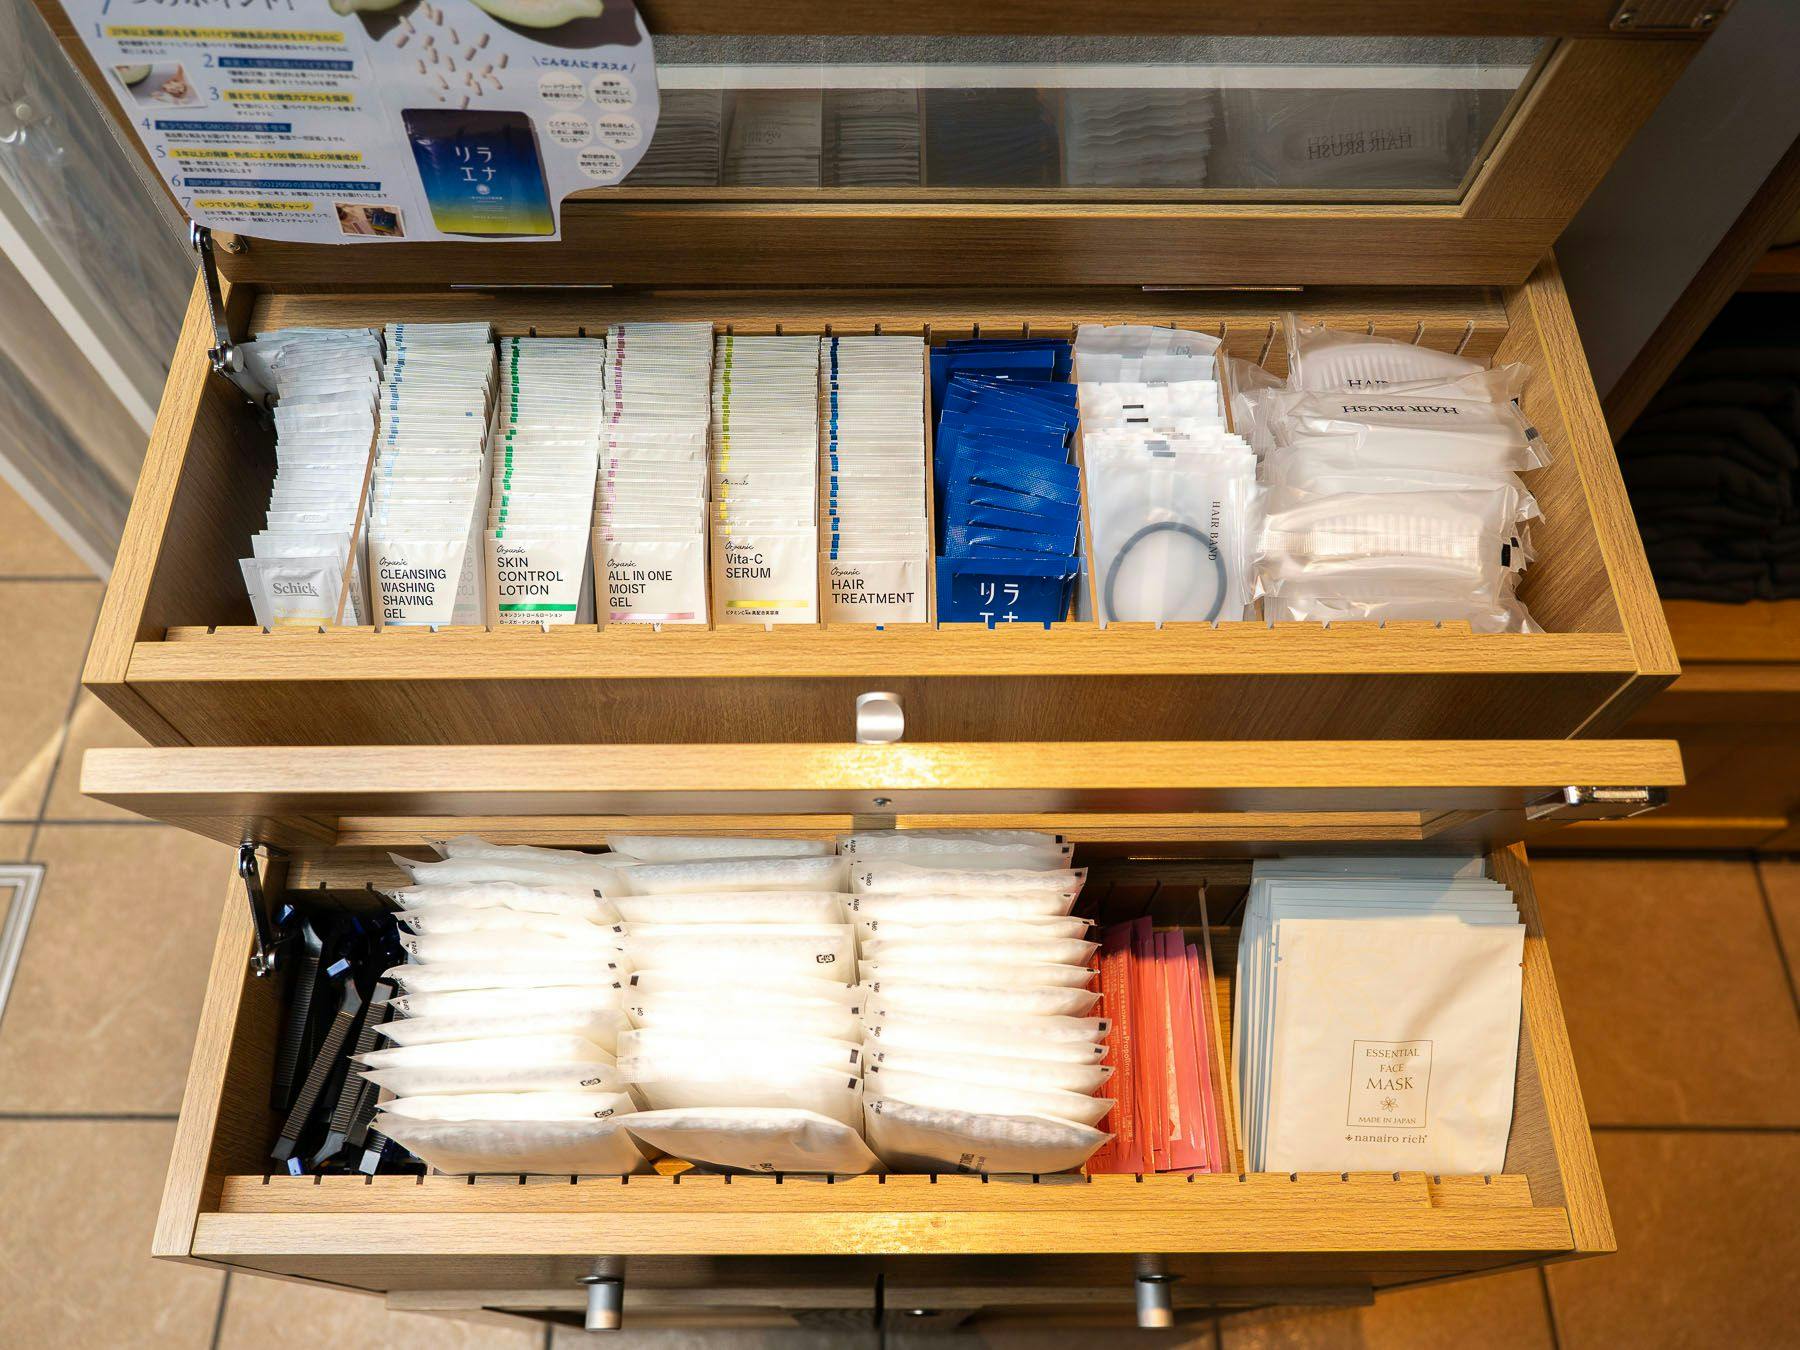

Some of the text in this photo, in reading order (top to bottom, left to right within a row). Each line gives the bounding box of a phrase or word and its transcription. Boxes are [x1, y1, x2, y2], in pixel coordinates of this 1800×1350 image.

[203, 54, 215, 69] 2
[209, 87, 220, 101] 3
[142, 118, 151, 131] 4
[154, 145, 167, 159] 5
[171, 174, 181, 187] 6
[182, 196, 191, 208] 7
[1342, 405, 1406, 414] BRUSH
[1208, 501, 1221, 561] HAIR BAND
[497, 544, 526, 554] Organic
[725, 541, 755, 551] Organic
[379, 556, 408, 567] Organic
[497, 557, 529, 568] SKIN
[607, 558, 637, 568] Organic
[726, 553, 764, 565] Vita-C
[380, 568, 447, 580] CLEANSING
[498, 570, 564, 582] CONTROL
[608, 570, 673, 581] ALL IN ONE
[726, 567, 772, 579] SERUM
[831, 566, 861, 576] Organic
[272, 582, 319, 597] Schick
[381, 582, 436, 593] WASHING
[609, 583, 647, 594] MOIST
[831, 579, 865, 590] HAIR
[499, 585, 550, 596] LOTION
[980, 582, 1020, 606] リラ
[382, 595, 434, 606] SHAVING
[609, 597, 633, 608] GEL
[831, 592, 915, 604] TREATMENT
[383, 608, 407, 619] GEL
[1366, 1048, 1420, 1059] ESSENTIAL
[1380, 1063, 1405, 1073] FACE
[1366, 1077, 1414, 1091] MASK
[1359, 1116, 1381, 1124] MADE
[1394, 1117, 1417, 1125] JAPAN
[1354, 1133, 1425, 1144] nanairo rich
